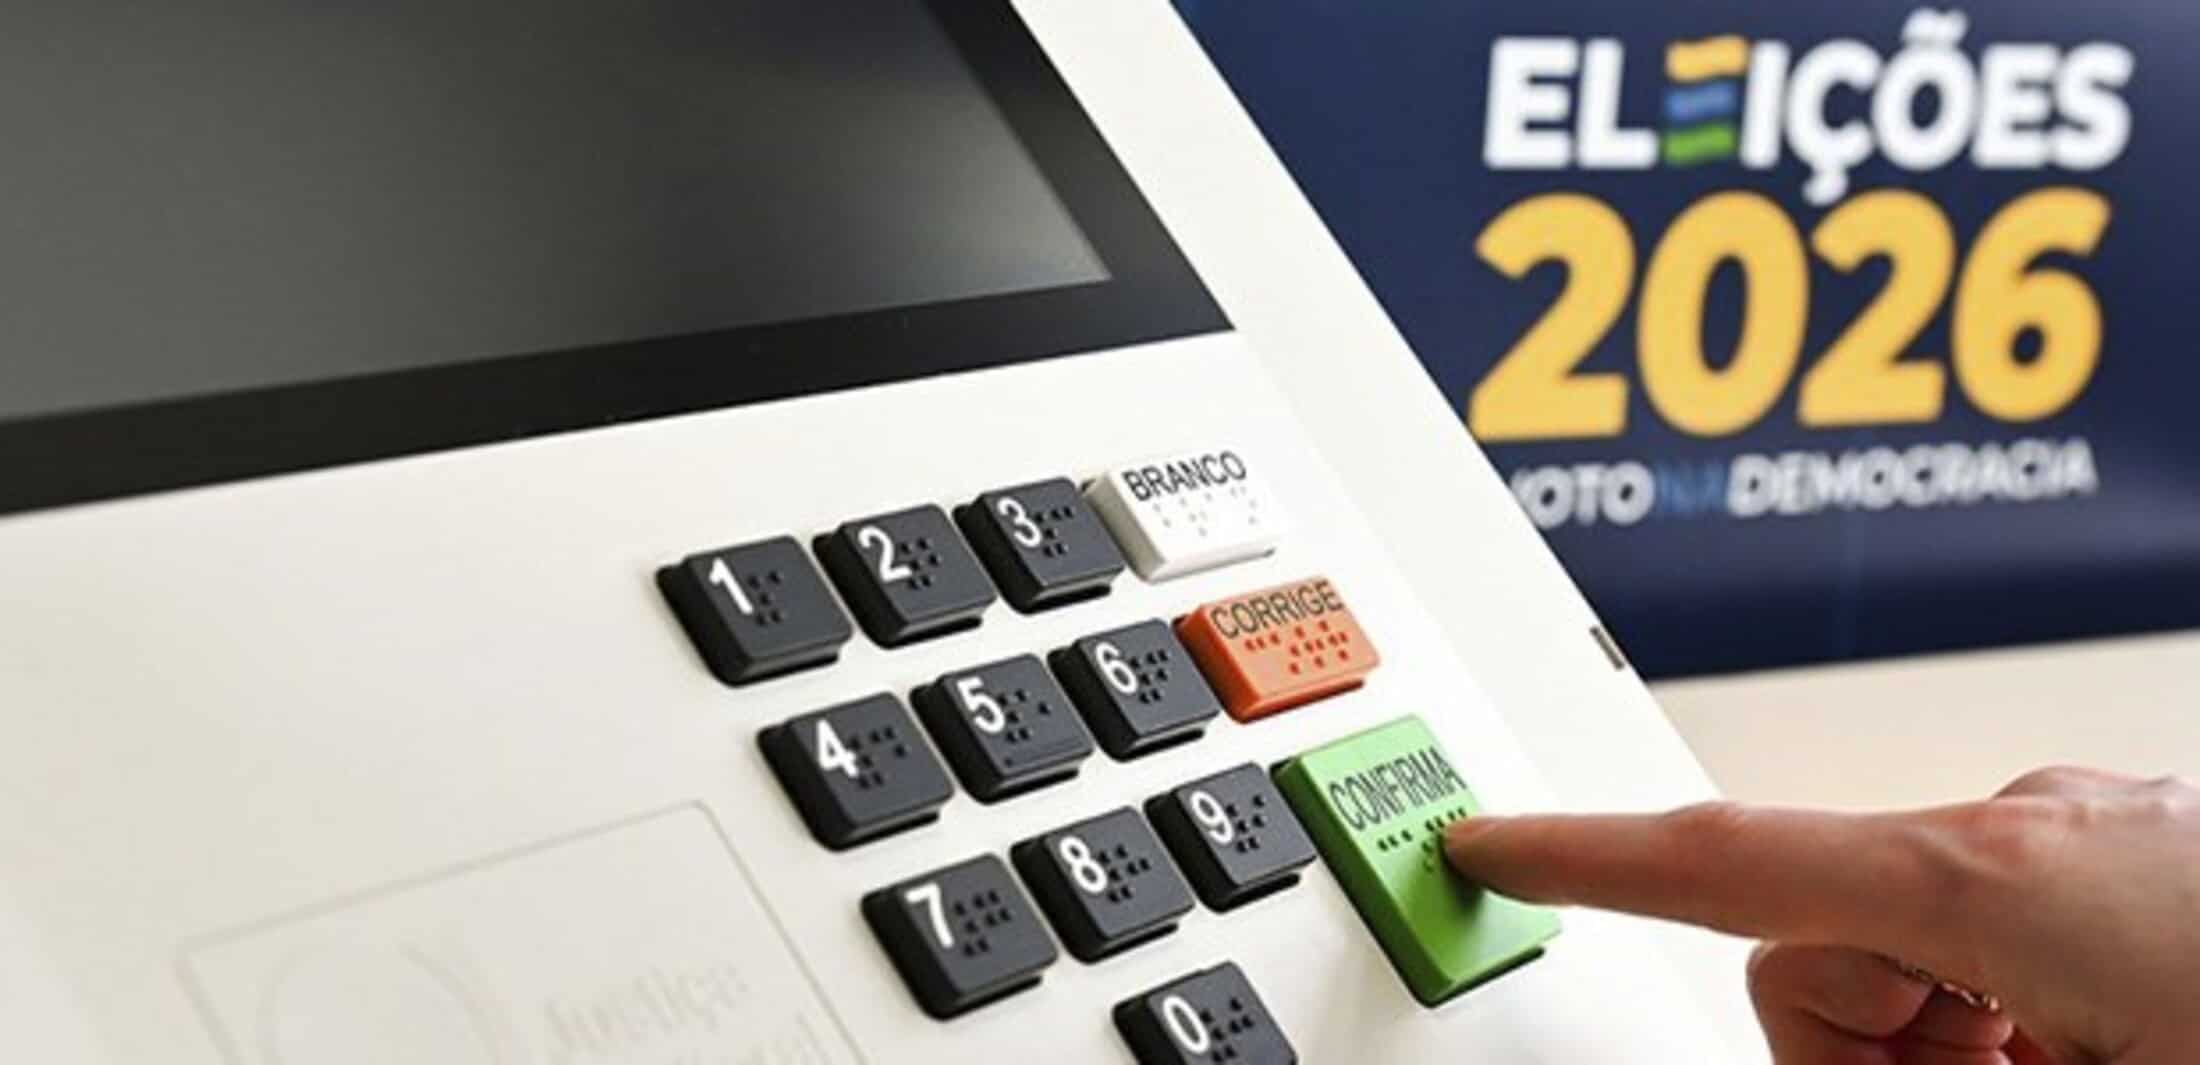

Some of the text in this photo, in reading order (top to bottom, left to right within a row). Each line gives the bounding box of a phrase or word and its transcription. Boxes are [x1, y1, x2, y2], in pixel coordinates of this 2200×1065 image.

[1484, 8, 2134, 206] ELEIÇÕES
[1470, 189, 2110, 441] 2026
[1122, 450, 1247, 501] BRANCO
[1728, 437, 2098, 518] DEMOCRACIA
[996, 496, 1044, 549] 3
[857, 525, 914, 583] 2
[708, 557, 754, 615] 1
[1210, 579, 1344, 639] CORRIGE
[1094, 640, 1140, 696] 6
[955, 675, 1007, 735] 5
[815, 718, 860, 778] 4
[1188, 789, 1236, 846] 9
[1328, 746, 1467, 832] CONFIRMA
[1057, 834, 1109, 895] 8
[904, 881, 955, 949] 7
[1161, 993, 1212, 1056] 0
